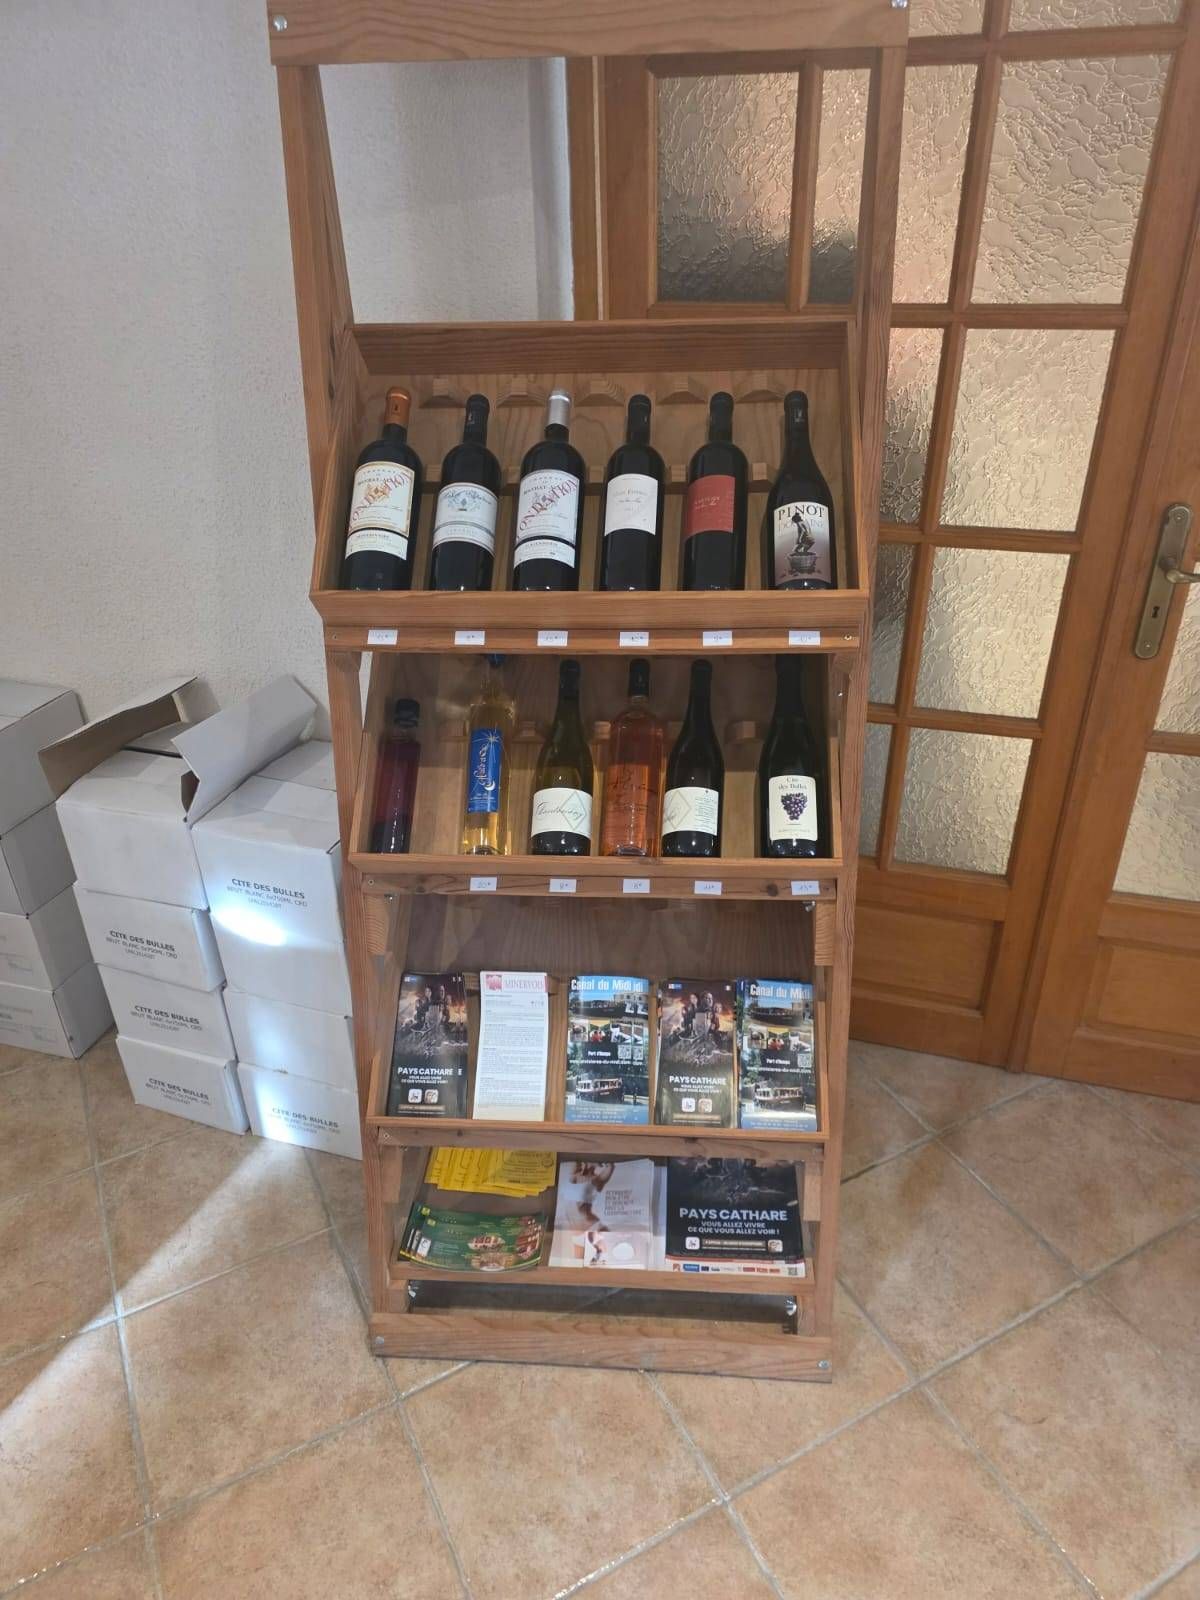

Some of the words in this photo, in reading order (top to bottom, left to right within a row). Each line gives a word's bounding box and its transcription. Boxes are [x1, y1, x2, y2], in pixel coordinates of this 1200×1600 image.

[778, 504, 825, 520] PINOT
[231, 878, 251, 888] CITE
[254, 882, 271, 892] DES
[273, 886, 305, 899] BULLES
[109, 930, 128, 940] CITE
[129, 935, 145, 945] DES
[146, 939, 175, 951] BULLES
[571, 979, 595, 991] Canal
[598, 979, 609, 990] du
[612, 979, 632, 991] Midi
[750, 984, 773, 997] Canal
[776, 986, 787, 998] du
[790, 987, 809, 999] Midi
[134, 1005, 153, 1014] CITE
[154, 1009, 170, 1018] DES
[171, 1013, 200, 1025] BULLES
[397, 1066, 418, 1075] PAYS
[419, 1067, 453, 1075] CATHARE
[669, 1075, 690, 1083] PAYS
[690, 1076, 726, 1086] CATHARE
[148, 1078, 165, 1087] CITE
[167, 1083, 181, 1092] DES
[183, 1088, 209, 1100] BULLES
[293, 1111, 307, 1120] DES
[309, 1116, 339, 1128] BULLES
[679, 1207, 718, 1219] PAYS
[719, 1209, 788, 1221] CATHARE
[736, 1227, 756, 1235] ALLEZ
